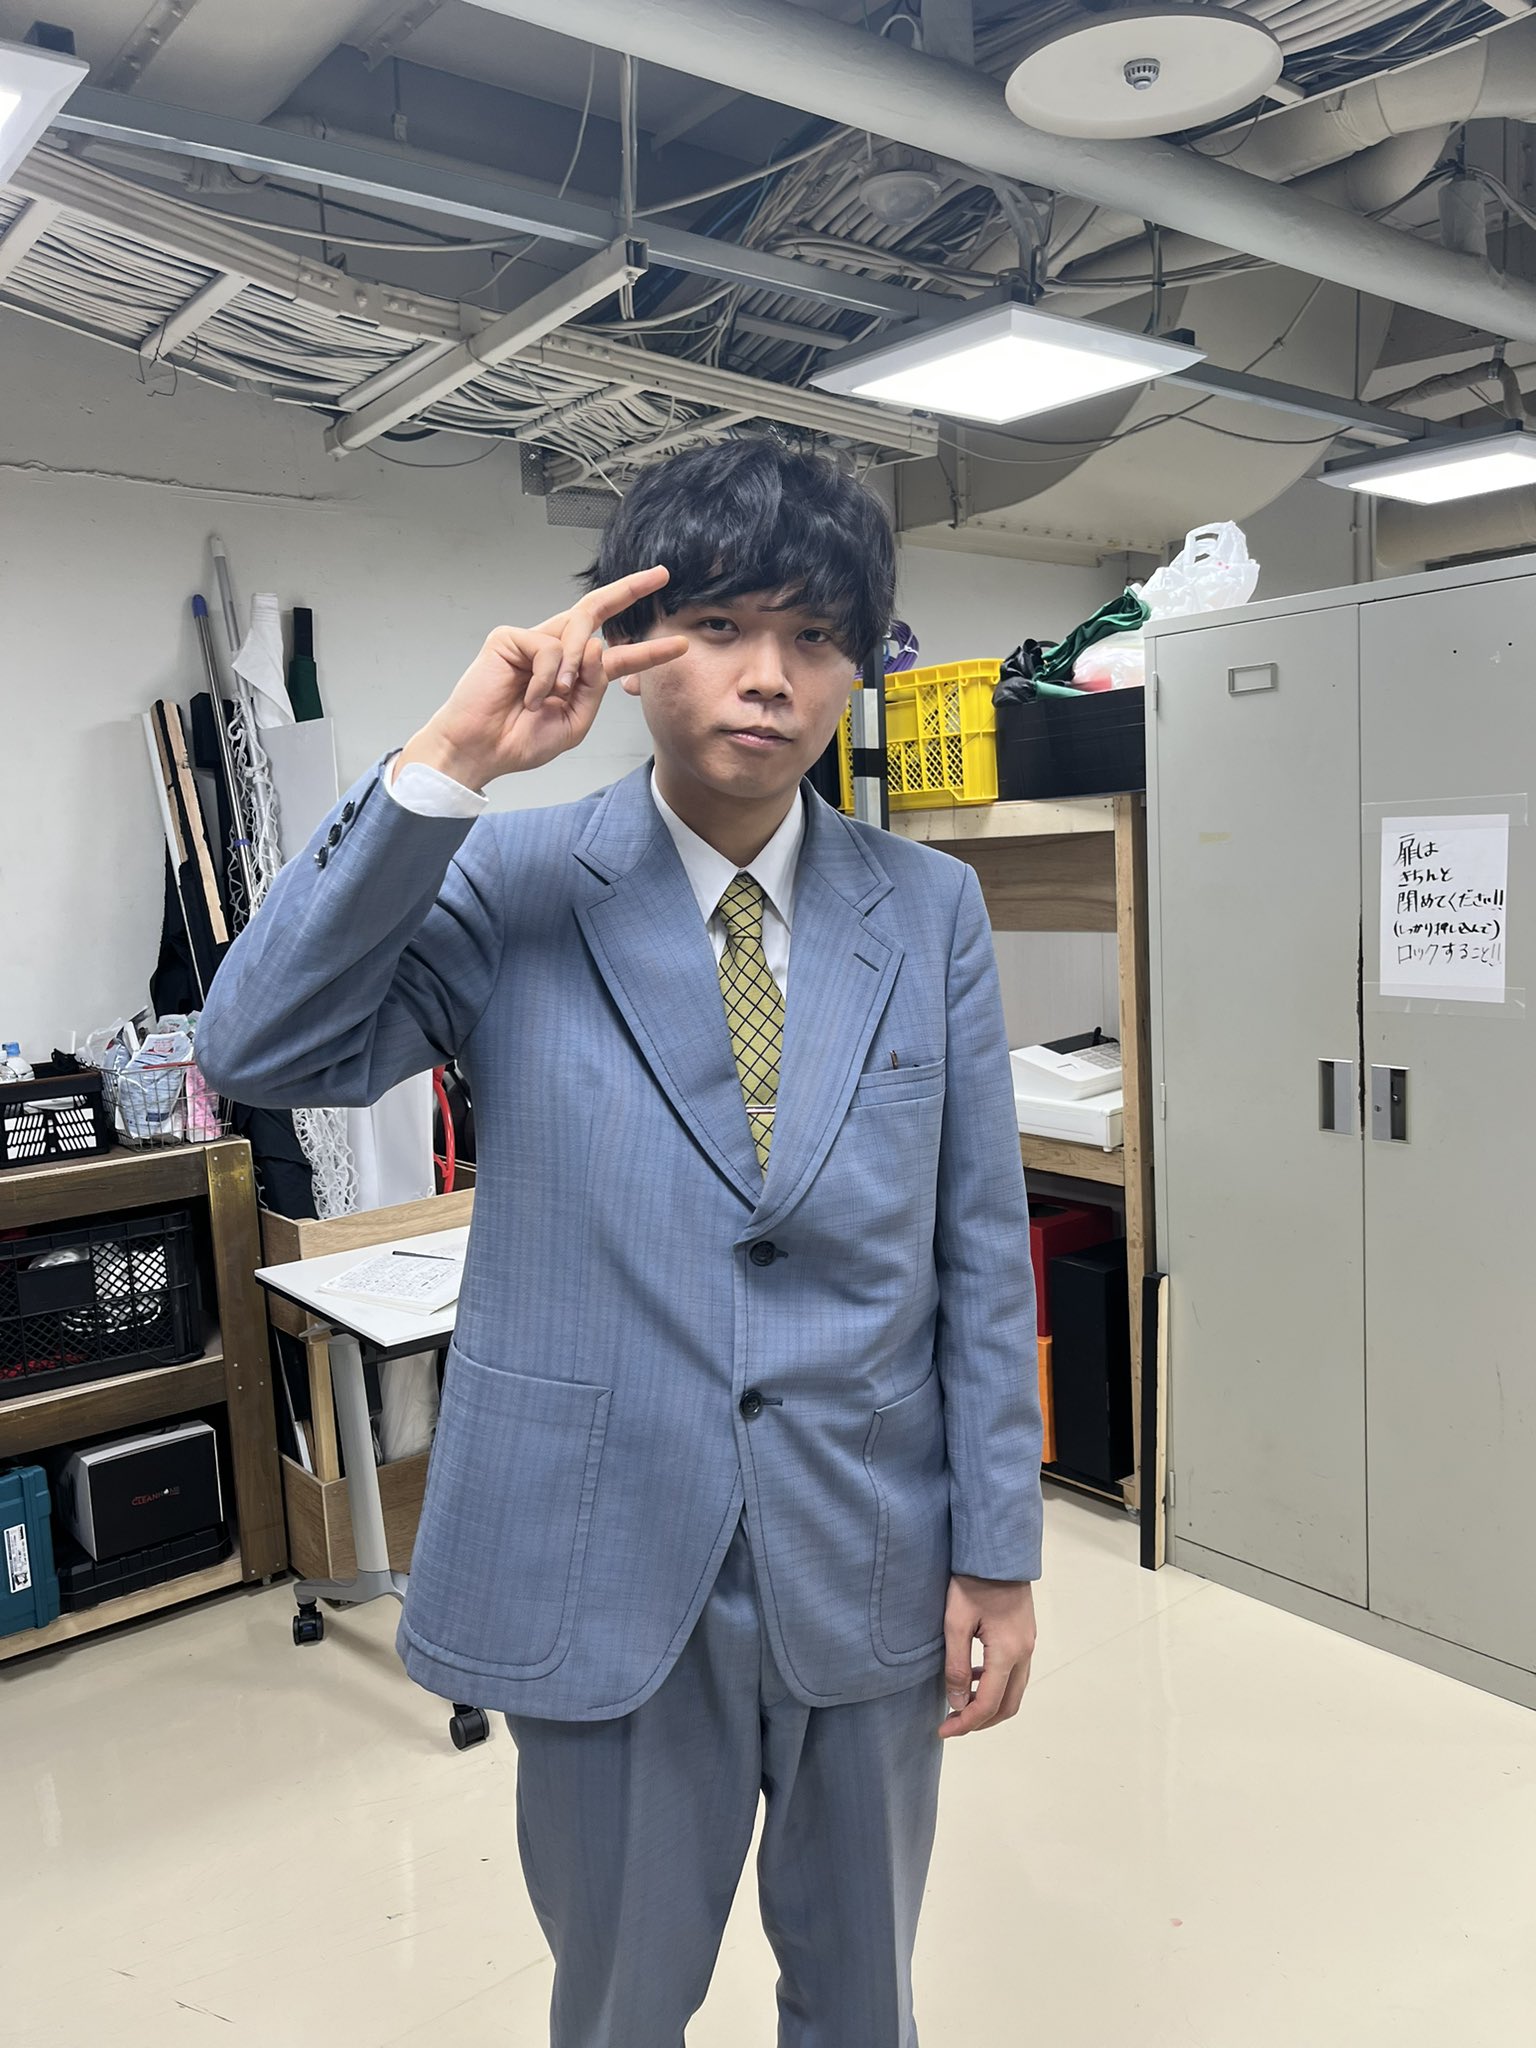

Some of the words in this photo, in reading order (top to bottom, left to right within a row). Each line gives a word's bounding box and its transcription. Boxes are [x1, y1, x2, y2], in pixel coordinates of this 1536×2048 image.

[1394, 834, 1439, 867] 扉は
[1398, 867, 1454, 888] きちんと
